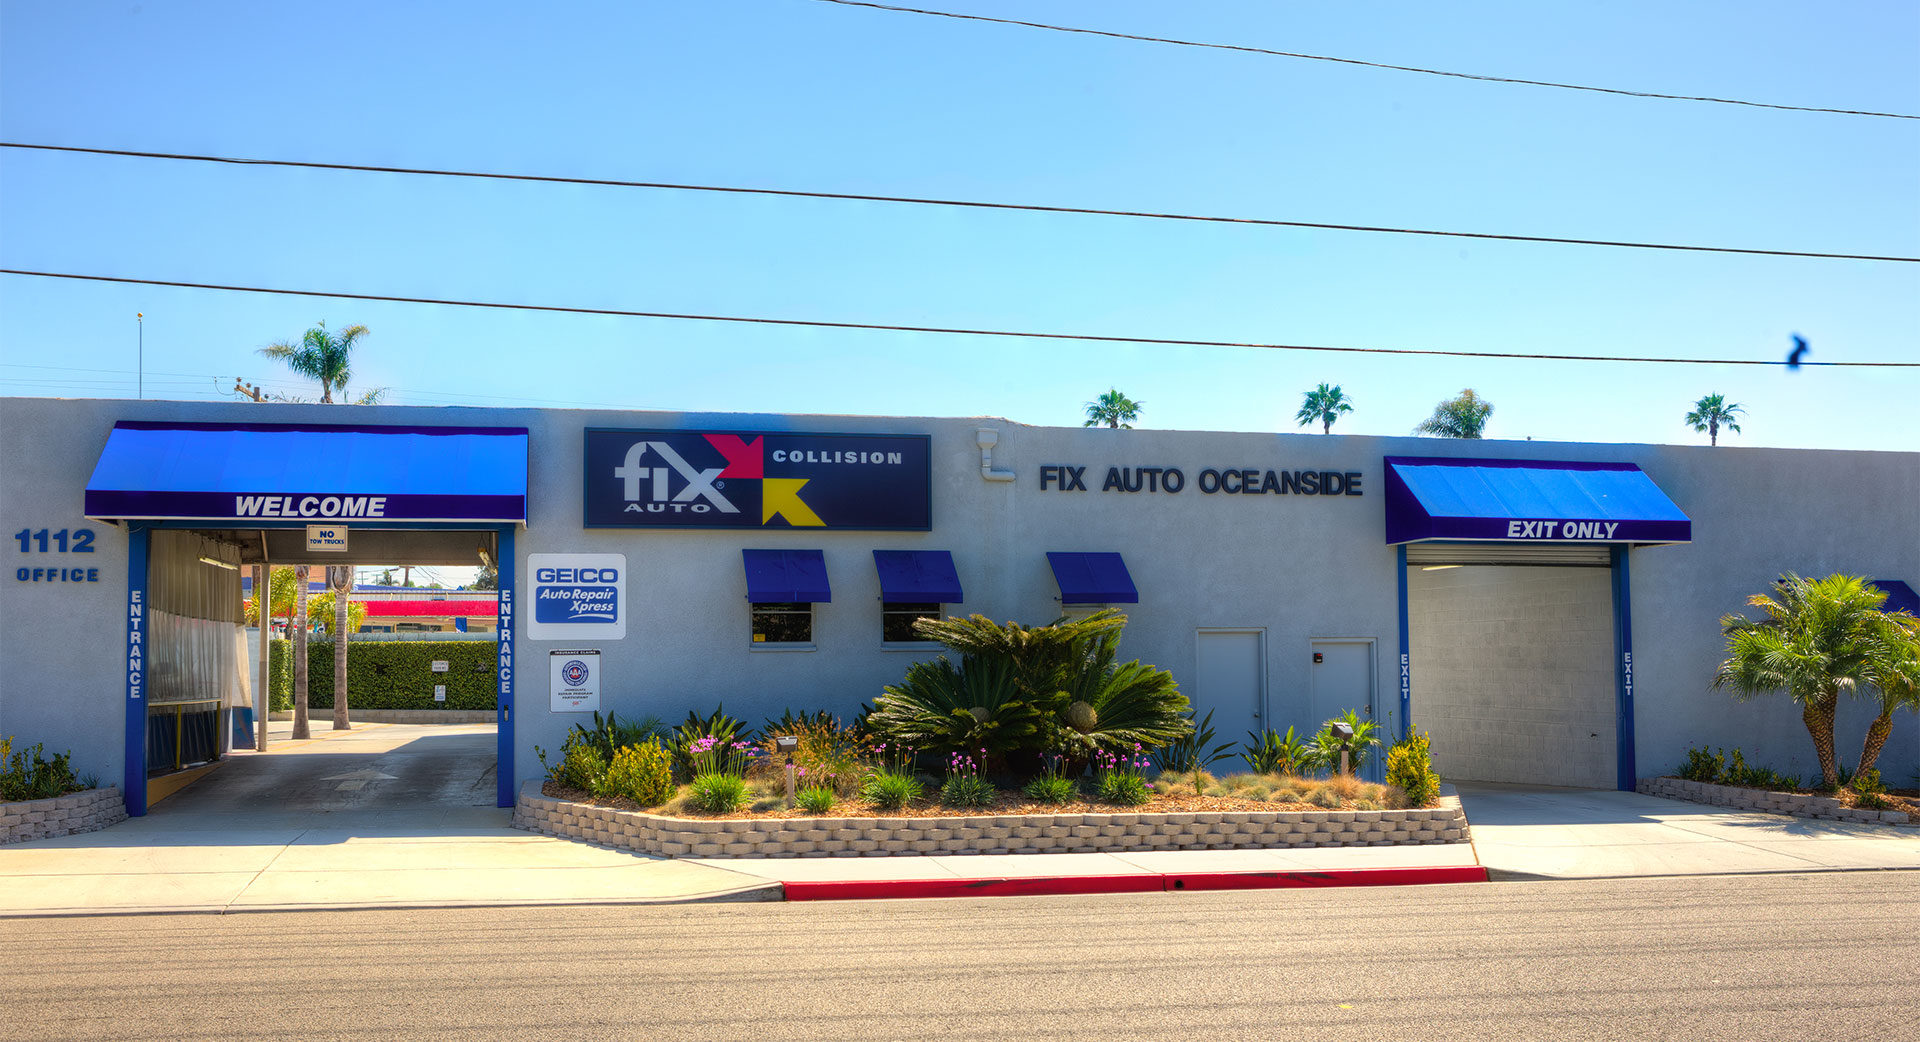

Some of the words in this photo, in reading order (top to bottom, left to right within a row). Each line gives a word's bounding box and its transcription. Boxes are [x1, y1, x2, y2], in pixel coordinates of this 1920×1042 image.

[772, 449, 902, 465] COLLISION
[1040, 466, 1087, 491] FIX
[1103, 467, 1185, 493] AUTO
[1199, 469, 1363, 496] OCEANSIDE
[235, 496, 387, 517] WELCOME
[623, 503, 711, 513] AUTO
[319, 530, 335, 538] NO
[1507, 520, 1558, 538] EXIT
[1562, 522, 1619, 539] ONLY
[14, 528, 96, 553] 1112
[16, 568, 99, 582] OFFICE
[536, 568, 618, 583] GEICO
[540, 588, 571, 600] Auto
[571, 588, 615, 602] Repair
[569, 600, 614, 614] Xpress
[129, 590, 142, 698] ENTRANCE
[500, 589, 512, 693] ENTRANCE
[1401, 653, 1409, 699] EXIT
[1624, 652, 1633, 696] EXIT
